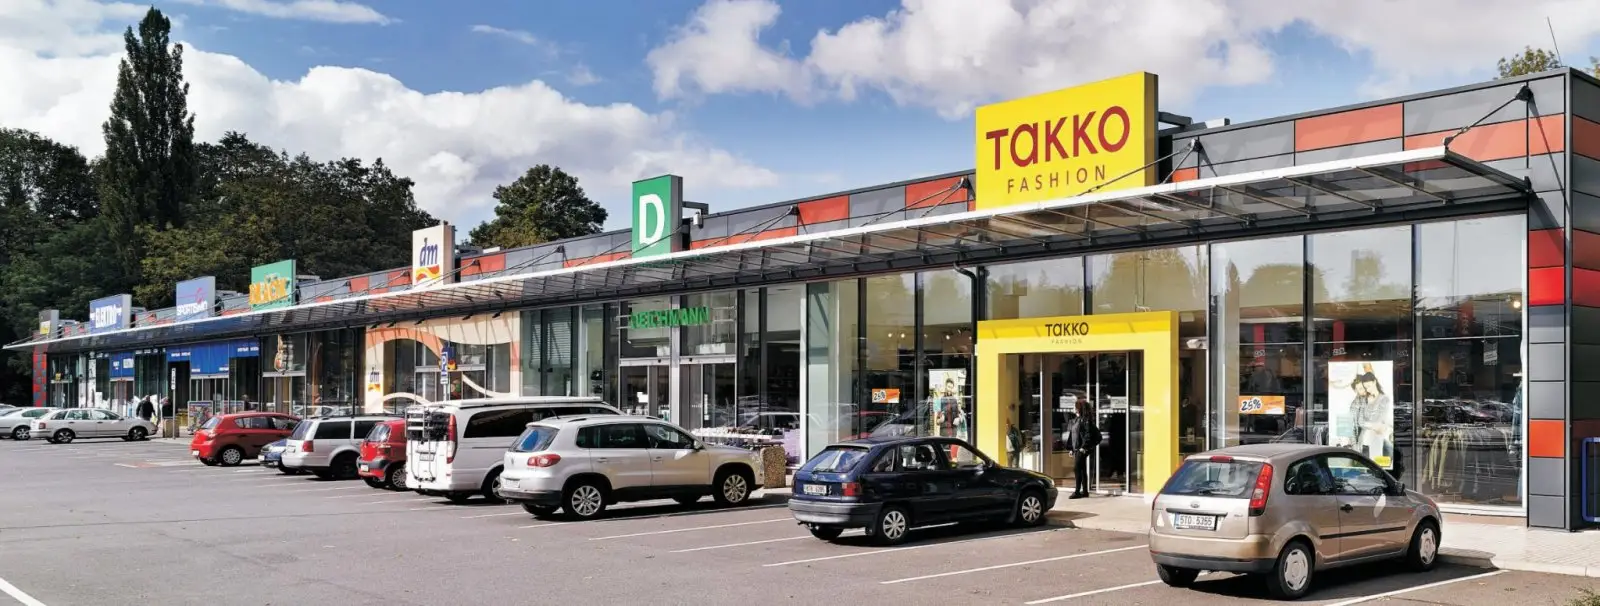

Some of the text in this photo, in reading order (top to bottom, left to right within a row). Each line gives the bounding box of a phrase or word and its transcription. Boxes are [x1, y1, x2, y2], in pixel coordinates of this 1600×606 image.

[1007, 164, 1106, 194] FASHION
[638, 193, 666, 249] D
[419, 237, 439, 267] dm
[631, 306, 711, 329] DEICHMANN
[1241, 398, 1262, 411] 25%
